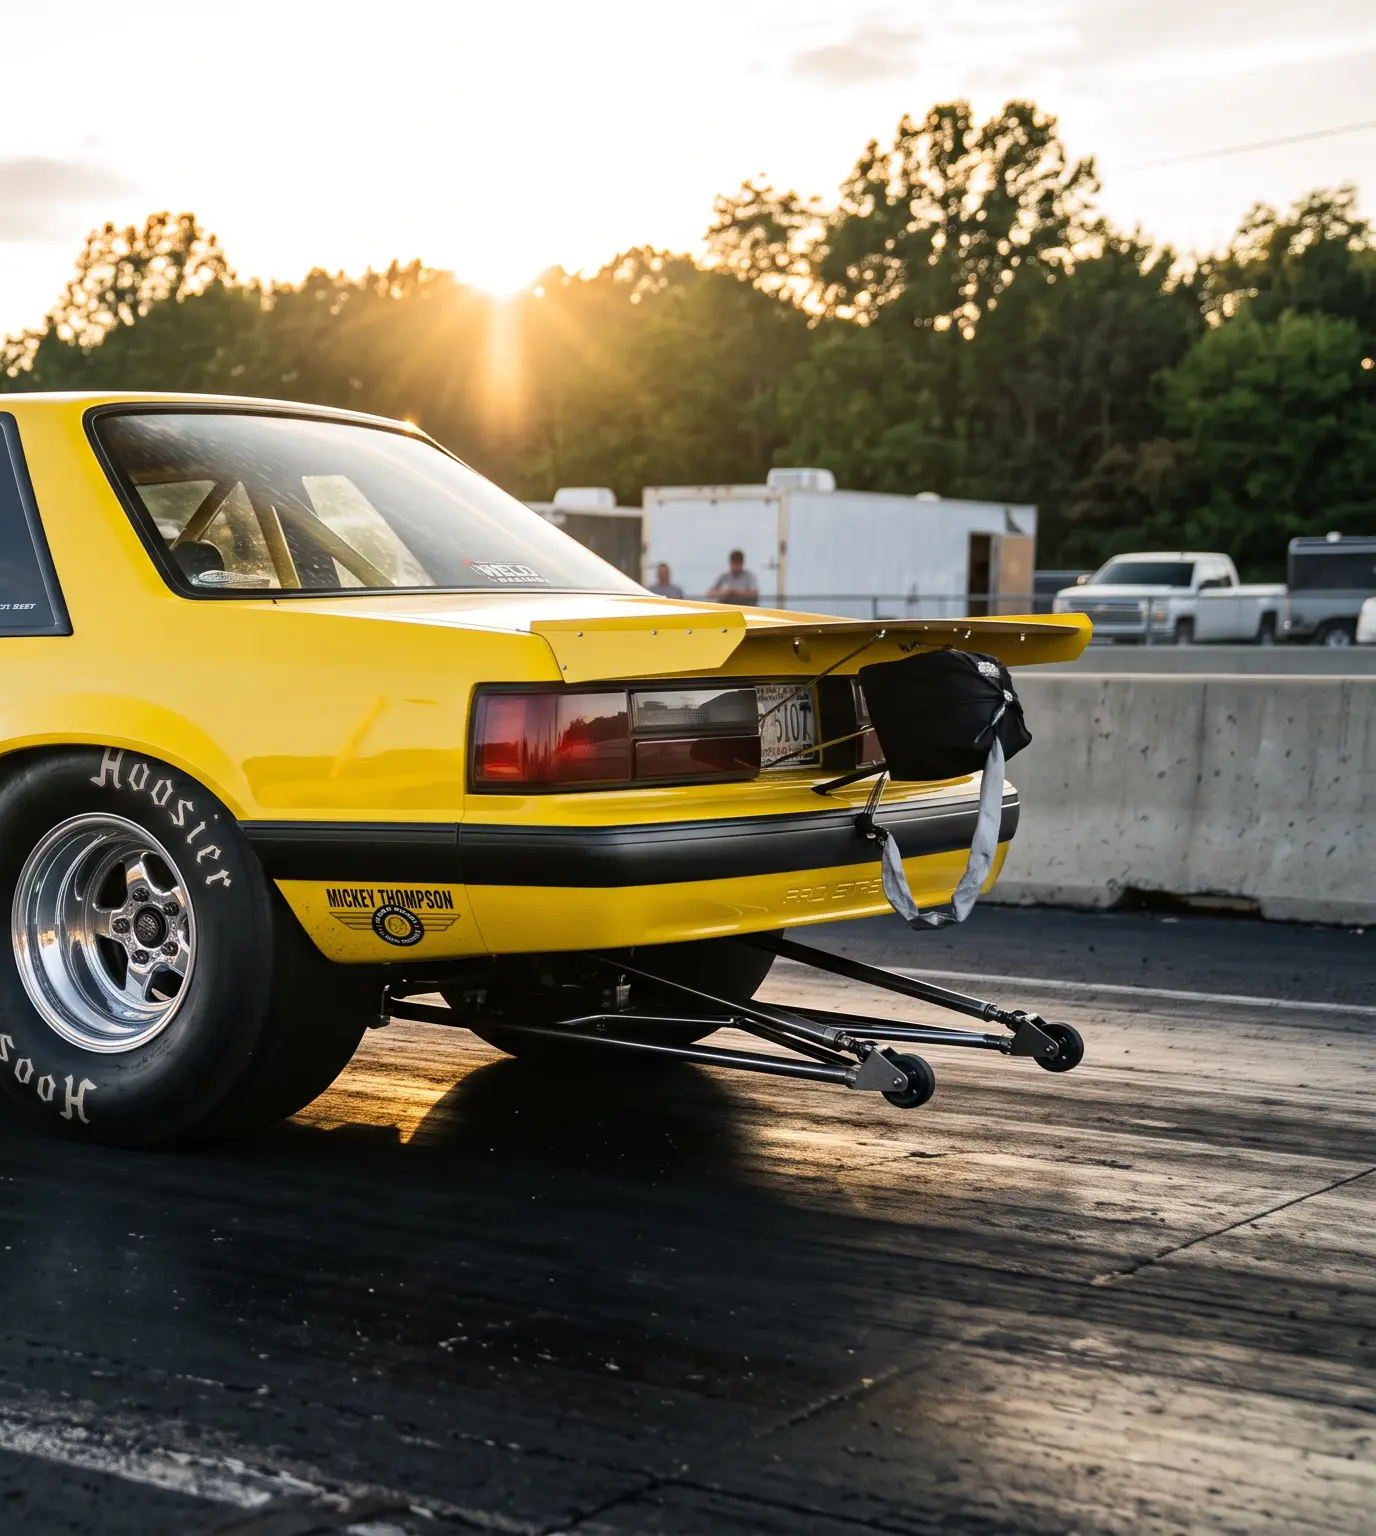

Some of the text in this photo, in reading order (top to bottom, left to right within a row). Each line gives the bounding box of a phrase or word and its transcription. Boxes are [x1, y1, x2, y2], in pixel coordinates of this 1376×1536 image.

[90, 747, 232, 887] Hoosier
[326, 888, 455, 909] MICKEY THOMPSON
